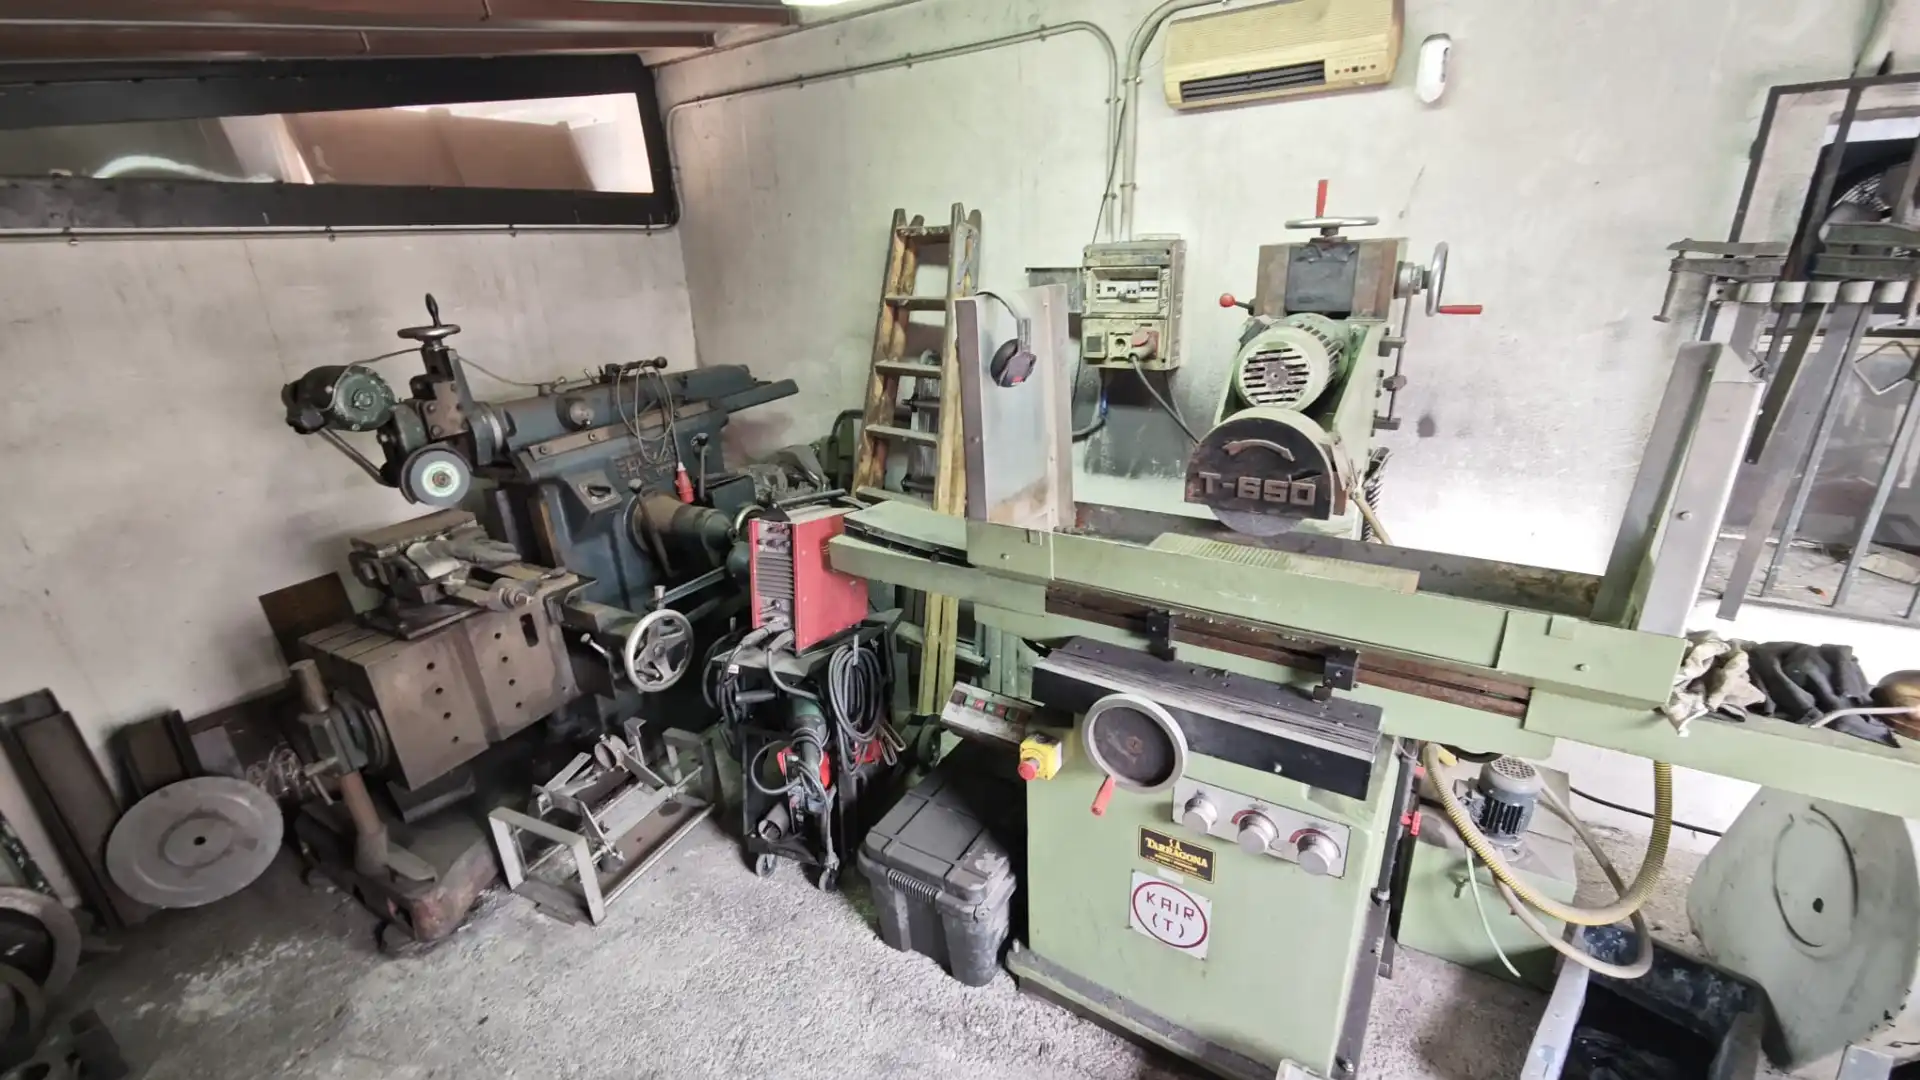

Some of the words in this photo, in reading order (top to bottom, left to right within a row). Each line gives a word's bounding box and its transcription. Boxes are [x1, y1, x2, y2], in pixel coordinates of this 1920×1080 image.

[1198, 472, 1316, 505] T-650
[1144, 837, 1208, 868] TARRAGONA
[1145, 891, 1195, 921] KAIR
[1152, 912, 1185, 939] (T)
